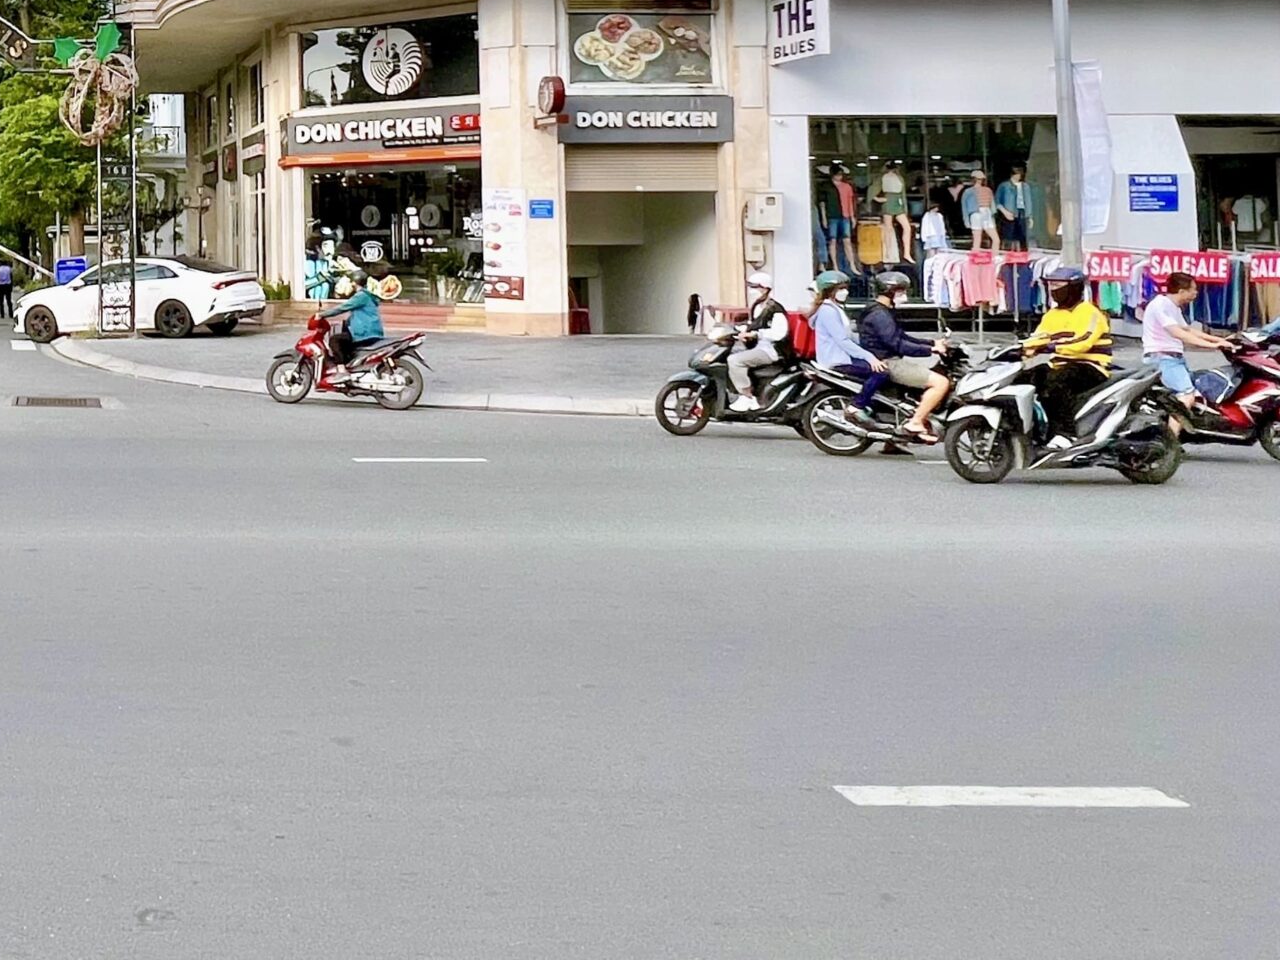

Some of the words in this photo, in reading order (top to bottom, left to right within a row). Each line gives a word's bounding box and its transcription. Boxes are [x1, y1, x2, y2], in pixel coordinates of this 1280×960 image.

[773, 38, 816, 59] BLUES
[295, 122, 342, 144] DON
[343, 115, 444, 140] CHICKEN
[576, 111, 624, 128] DON
[626, 111, 718, 128] CHICKEN
[1091, 255, 1131, 277] SALE
[1151, 254, 1192, 276] SALE
